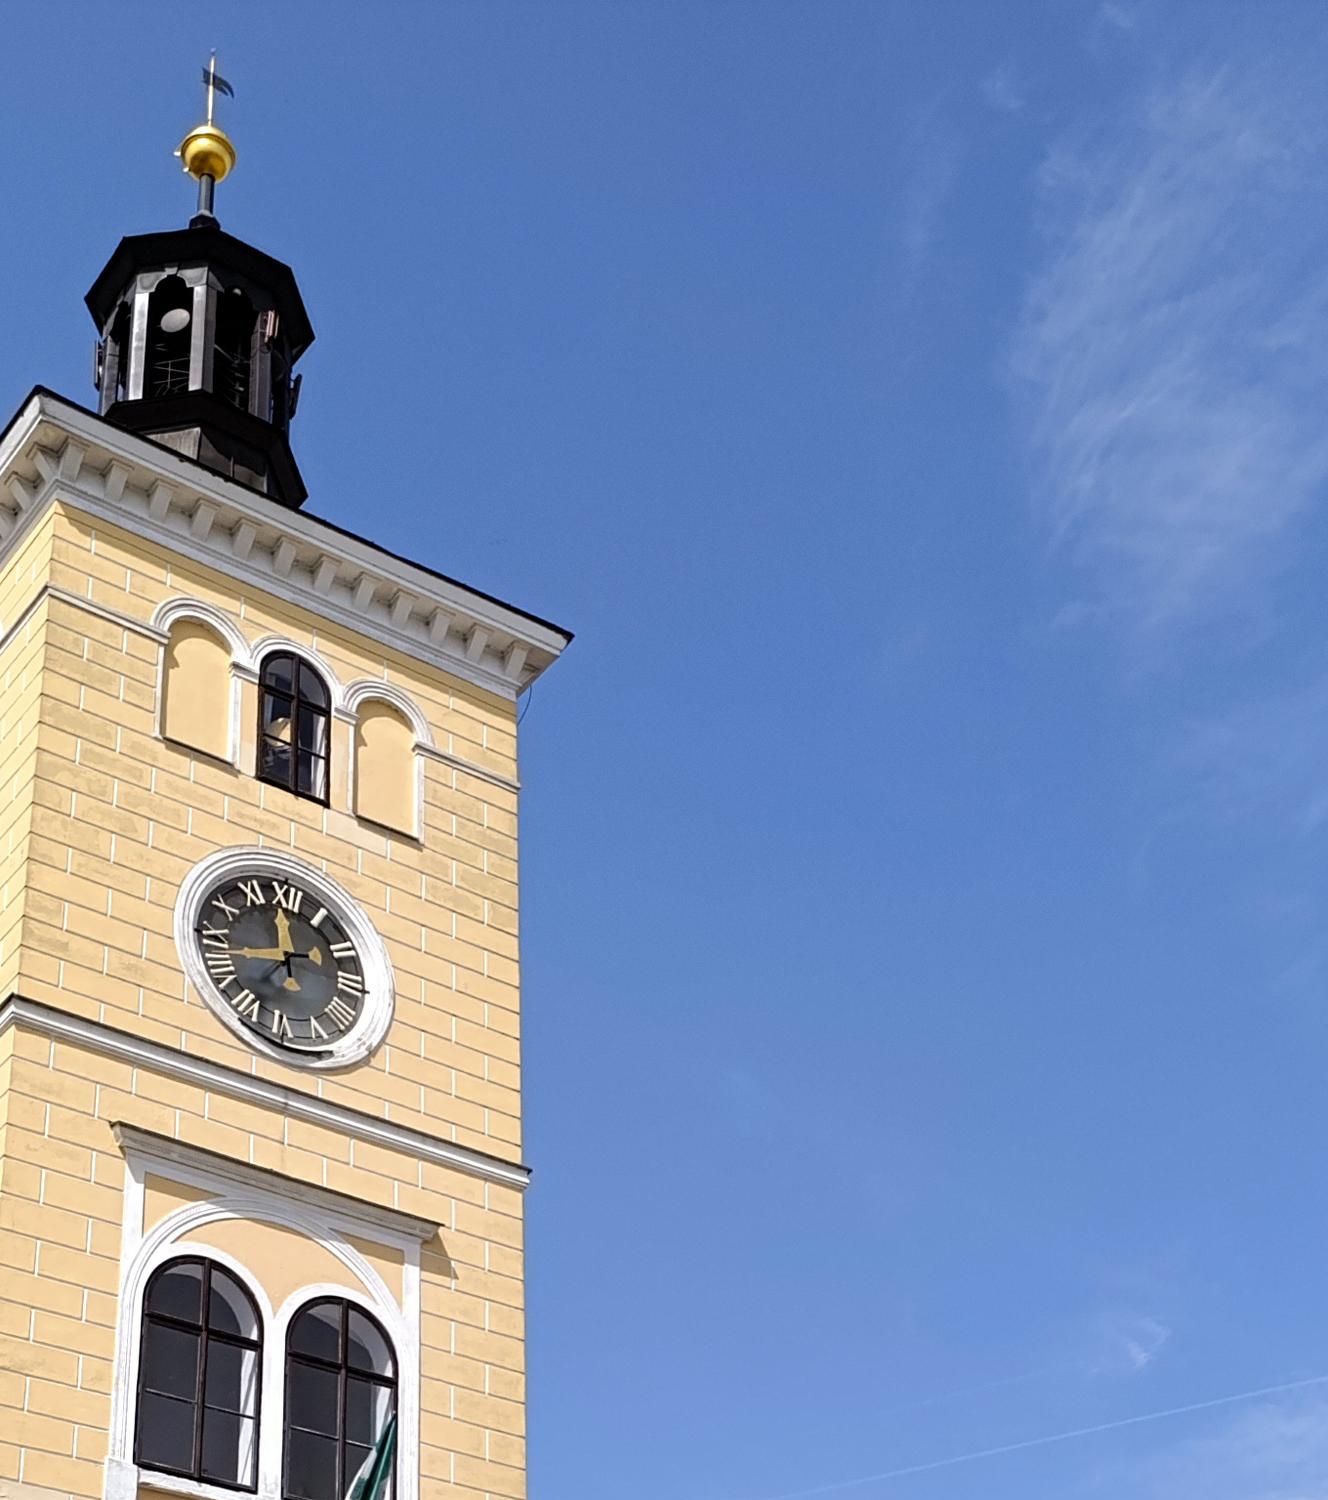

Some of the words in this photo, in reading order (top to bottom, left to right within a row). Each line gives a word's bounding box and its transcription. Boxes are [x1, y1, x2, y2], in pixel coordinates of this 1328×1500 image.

[237, 880, 266, 907] XI
[272, 881, 303, 914] XII
[211, 894, 240, 921] X
[329, 941, 357, 958] II
